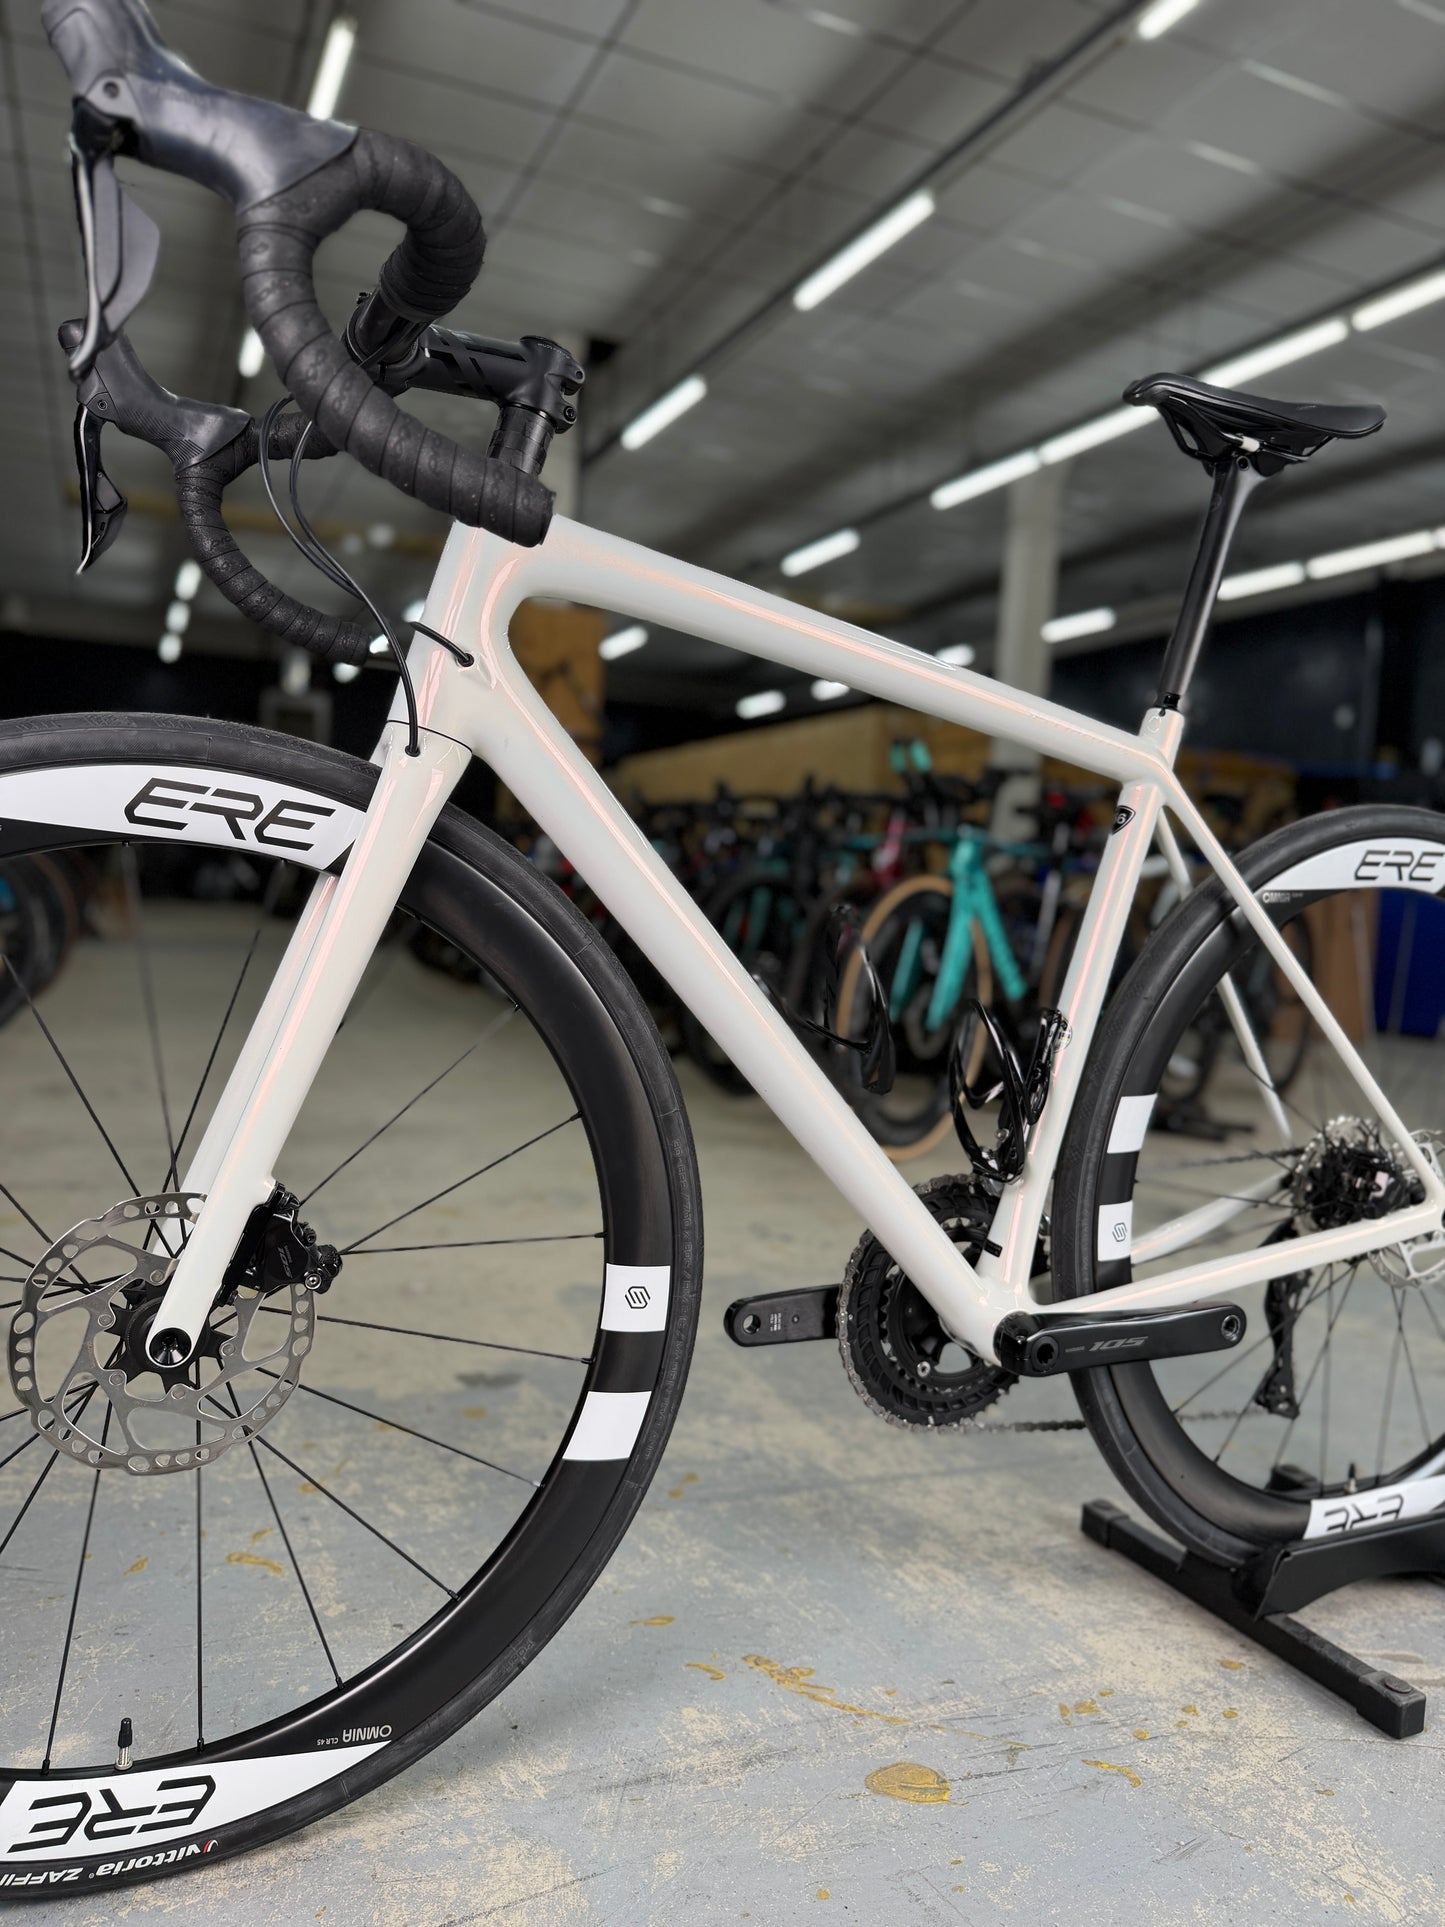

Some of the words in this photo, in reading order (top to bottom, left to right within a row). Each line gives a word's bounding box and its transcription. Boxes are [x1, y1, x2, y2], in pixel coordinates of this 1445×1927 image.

[124, 777, 336, 851] ERE
[1355, 850, 1444, 881] ERE
[1089, 1336, 1149, 1352] 105
[342, 1725, 392, 1743] OMNIA
[7, 1775, 216, 1854] ERE
